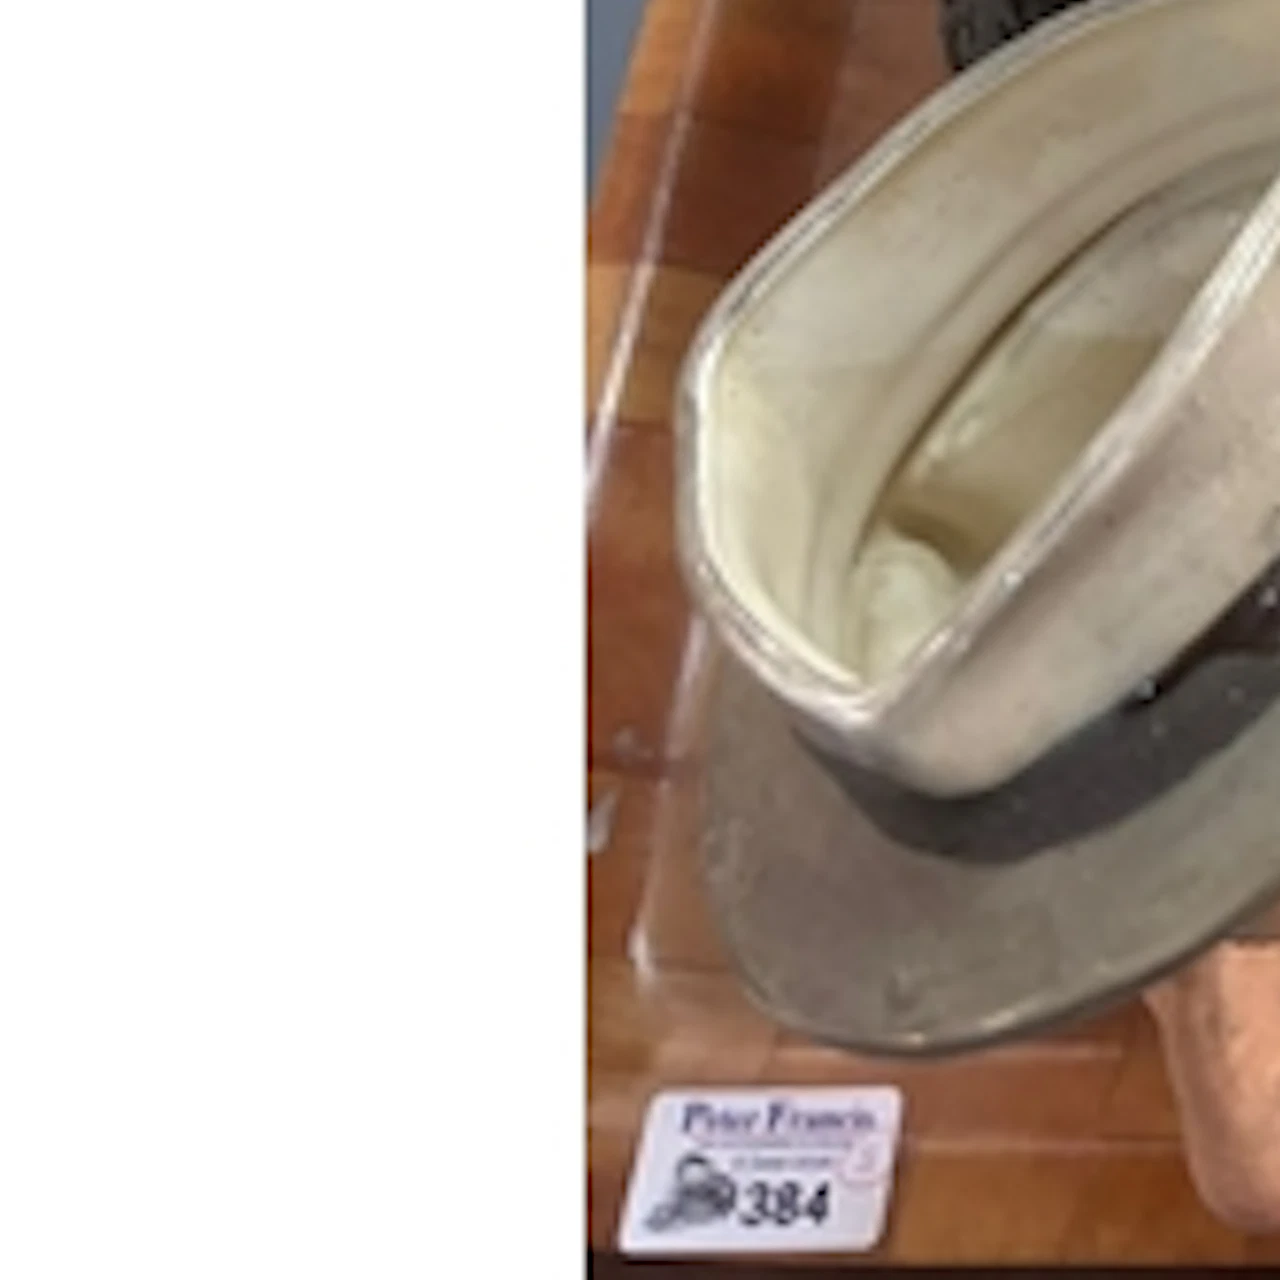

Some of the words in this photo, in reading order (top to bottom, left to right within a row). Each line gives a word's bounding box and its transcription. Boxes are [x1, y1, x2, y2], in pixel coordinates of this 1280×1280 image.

[682, 1101, 759, 1134] Peter
[765, 1101, 877, 1133] Francis
[737, 1179, 831, 1227] 384
